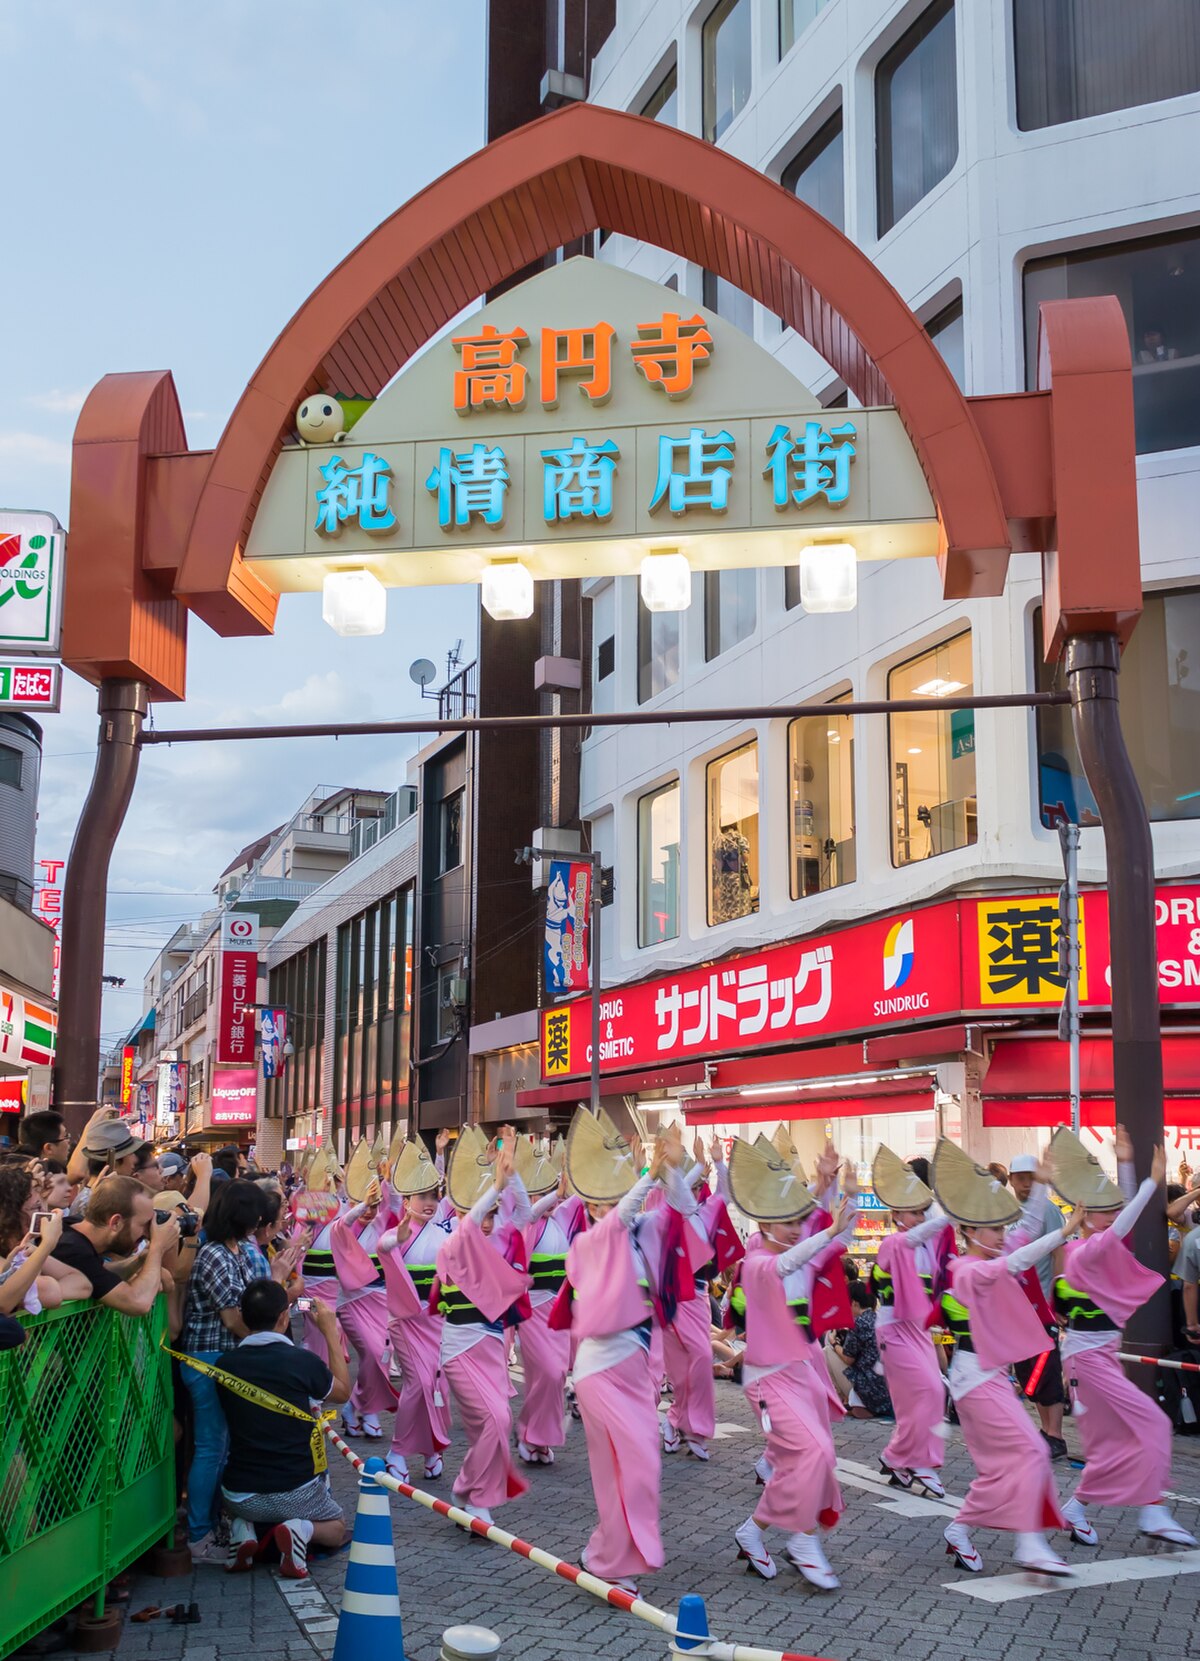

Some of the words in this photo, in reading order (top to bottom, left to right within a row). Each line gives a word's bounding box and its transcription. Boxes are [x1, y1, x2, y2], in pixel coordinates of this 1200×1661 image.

[452, 312, 712, 410] 高円寺
[314, 421, 858, 533] 純情商店街
[0, 567, 46, 580] OLDINGS
[14, 672, 50, 697] たばこ
[1154, 897, 1200, 926] DR
[228, 935, 253, 946] MUFG
[987, 904, 1068, 995] 薬
[229, 958, 248, 1054] 三菱UFJ銀行
[655, 945, 833, 1051] サンドラッグ
[873, 992, 929, 1017] SUNDRUG
[547, 1013, 568, 1070] 薬
[606, 1021, 614, 1039] &
[586, 1036, 634, 1063] CSMETIC
[214, 1111, 252, 1122] お売り下さい
